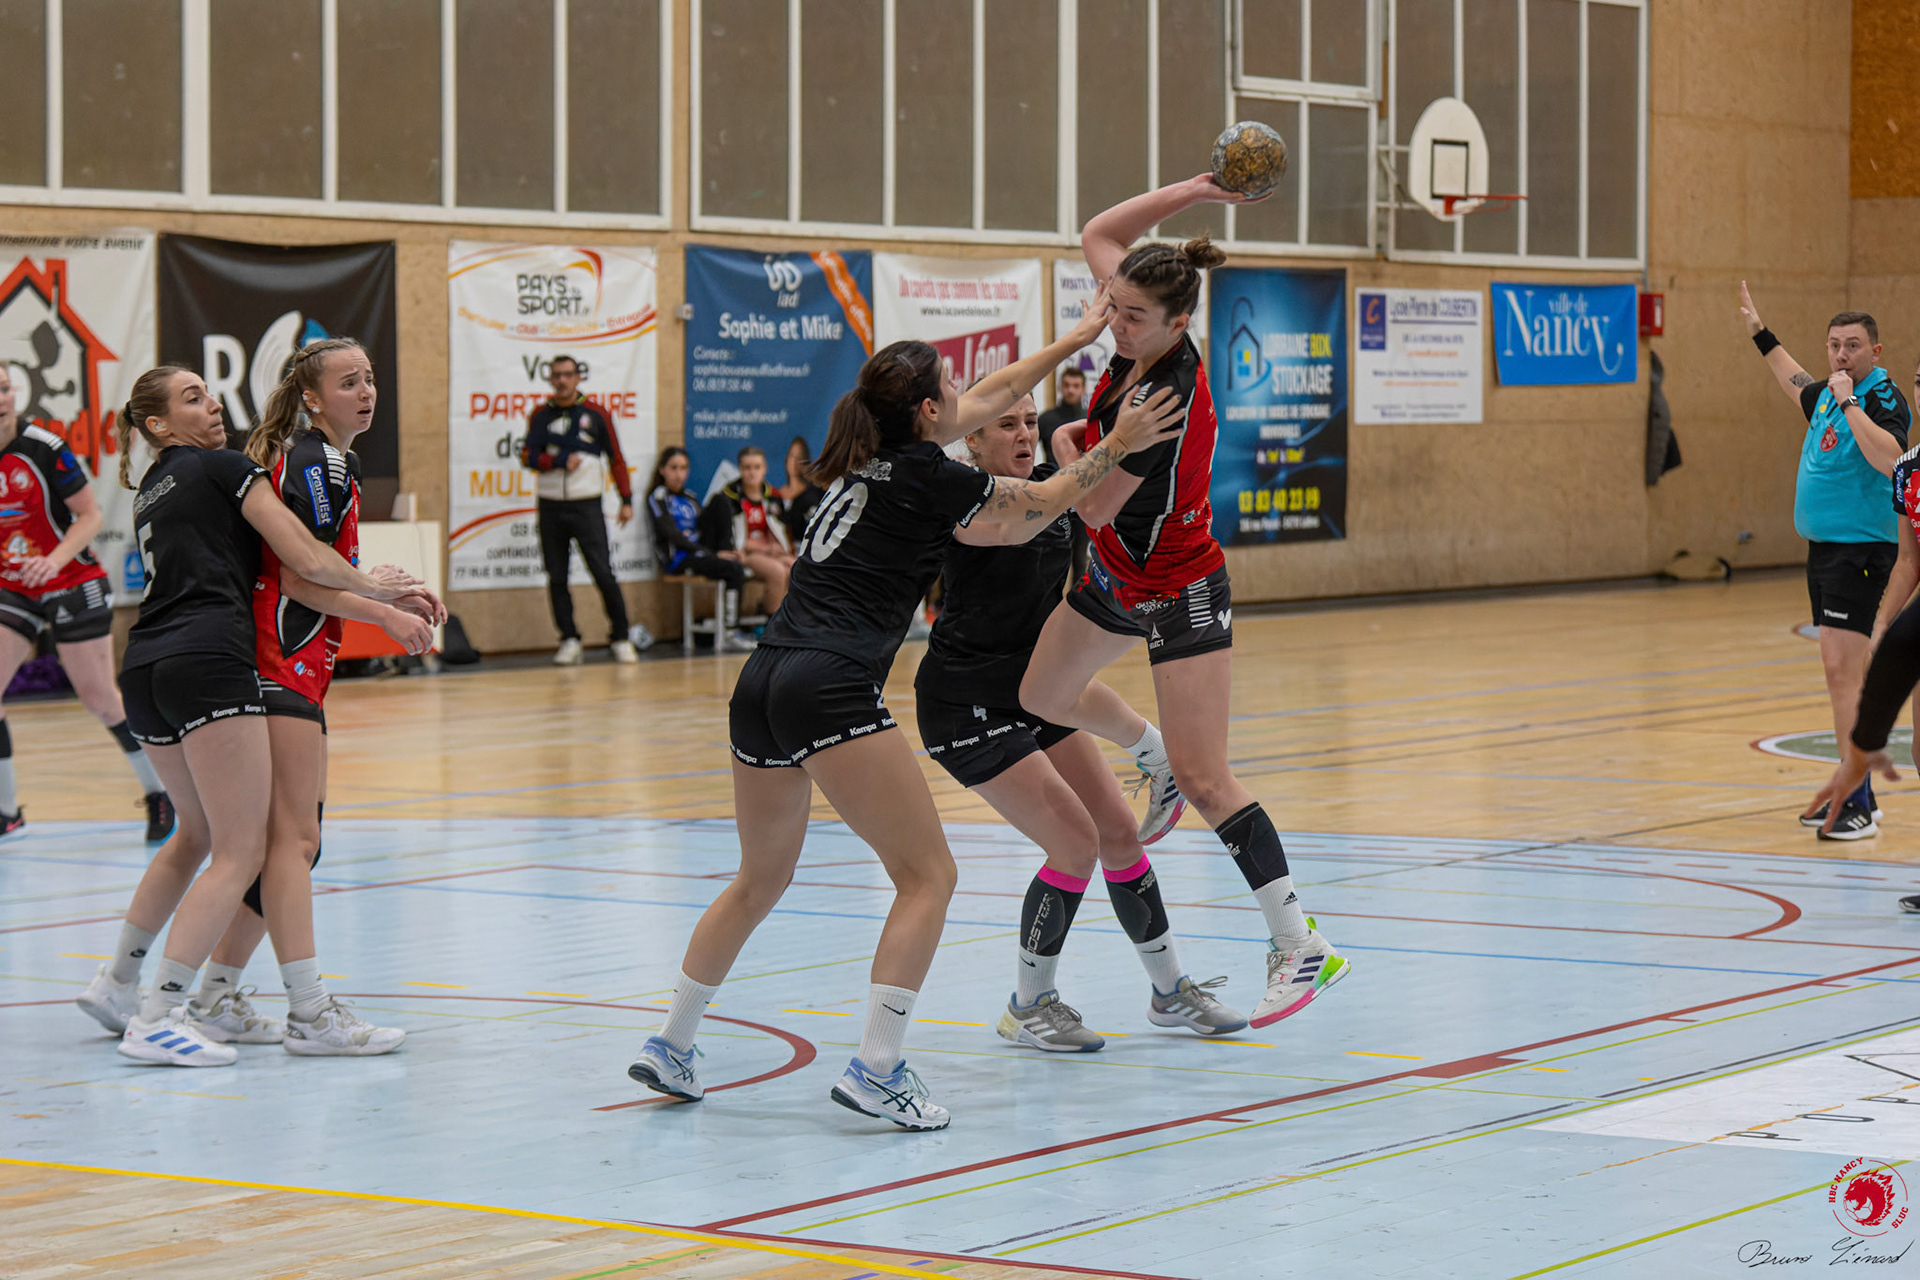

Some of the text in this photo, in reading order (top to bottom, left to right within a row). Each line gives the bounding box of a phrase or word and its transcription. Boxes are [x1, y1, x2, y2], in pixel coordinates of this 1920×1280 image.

[517, 274, 567, 294] PAYS
[1549, 292, 1573, 313] ville
[718, 312, 777, 345] Sophie
[779, 318, 800, 340] et
[1503, 289, 1624, 376] Nancy
[1309, 332, 1333, 358] BOX
[1272, 364, 1333, 395] STOCKAGE
[959, 502, 982, 527] Kempa
[211, 706, 240, 719] Kempa
[972, 705, 988, 722] 4
[736, 748, 758, 765] Kempa
[764, 758, 792, 767] Kempa
[812, 734, 842, 749] Kempa
[849, 723, 877, 737] Kempa
[951, 735, 980, 749] Kempa
[986, 724, 1013, 738] Kempa
